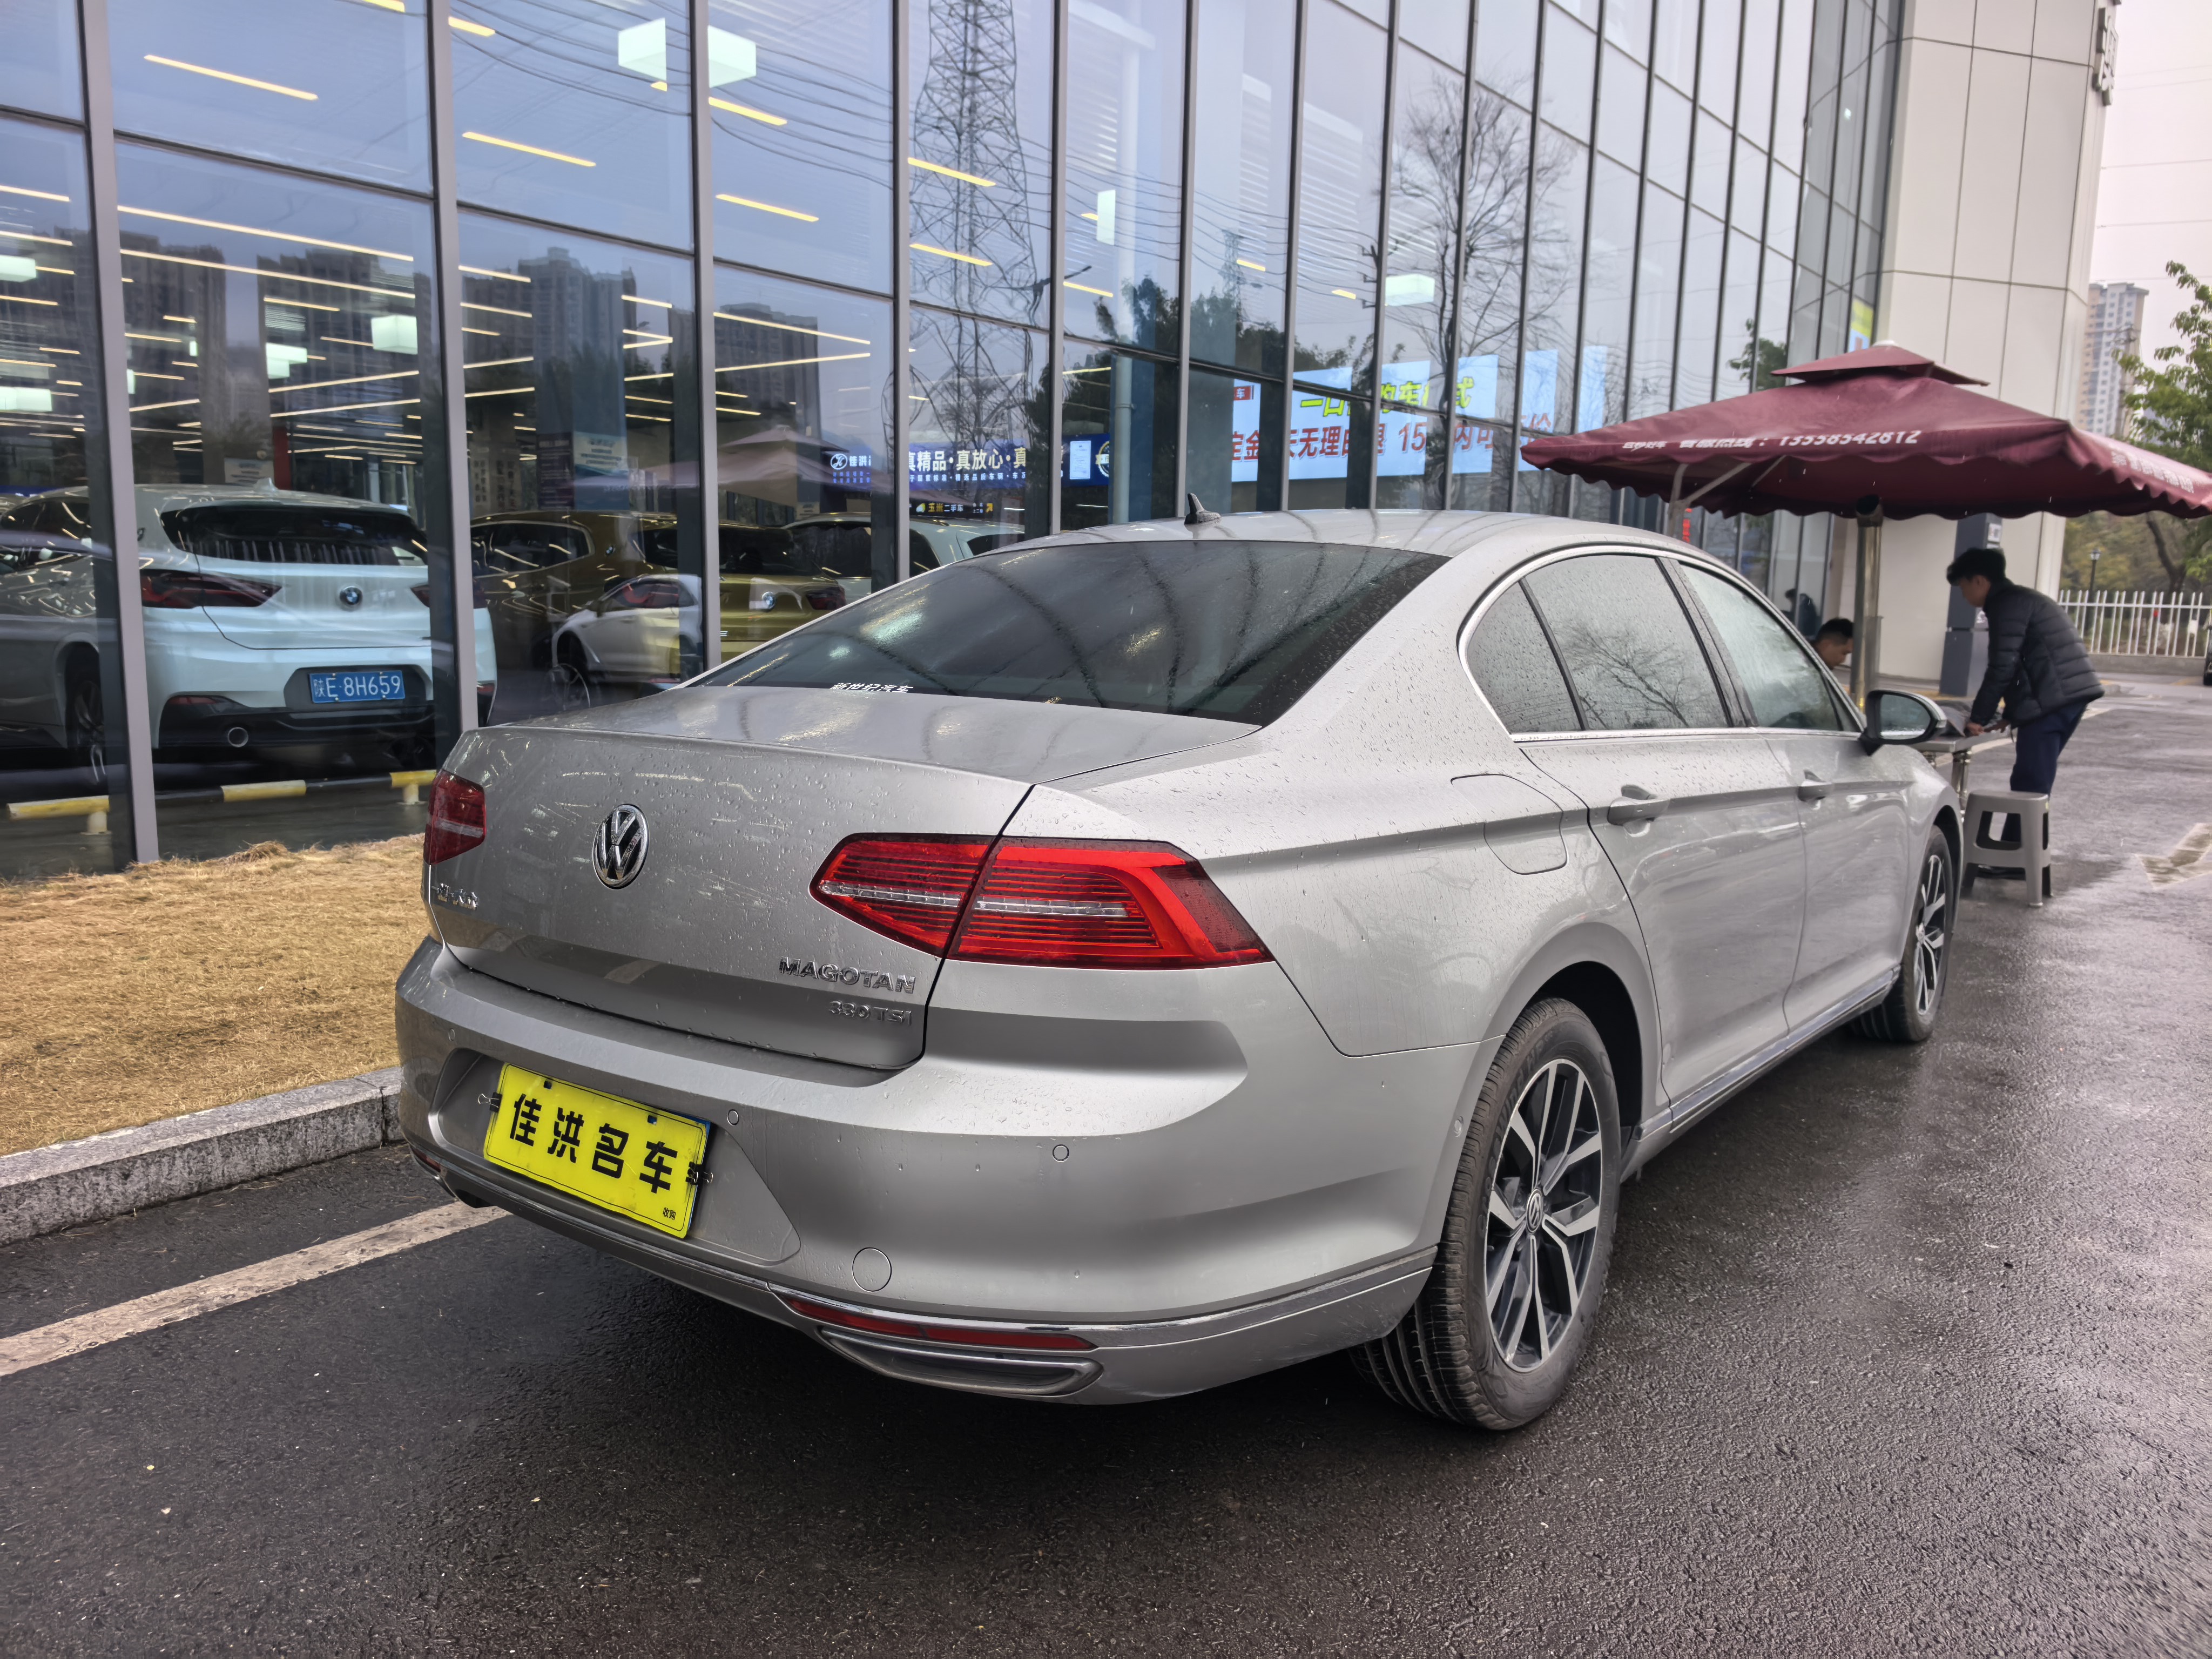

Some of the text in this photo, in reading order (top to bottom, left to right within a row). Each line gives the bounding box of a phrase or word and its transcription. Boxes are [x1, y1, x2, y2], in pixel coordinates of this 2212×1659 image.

[779, 956, 916, 994] MAGOTAN
[829, 1000, 912, 1026] 330 TSI
[510, 1094, 678, 1194] 佳洪名车
[663, 1207, 676, 1220] 收购
